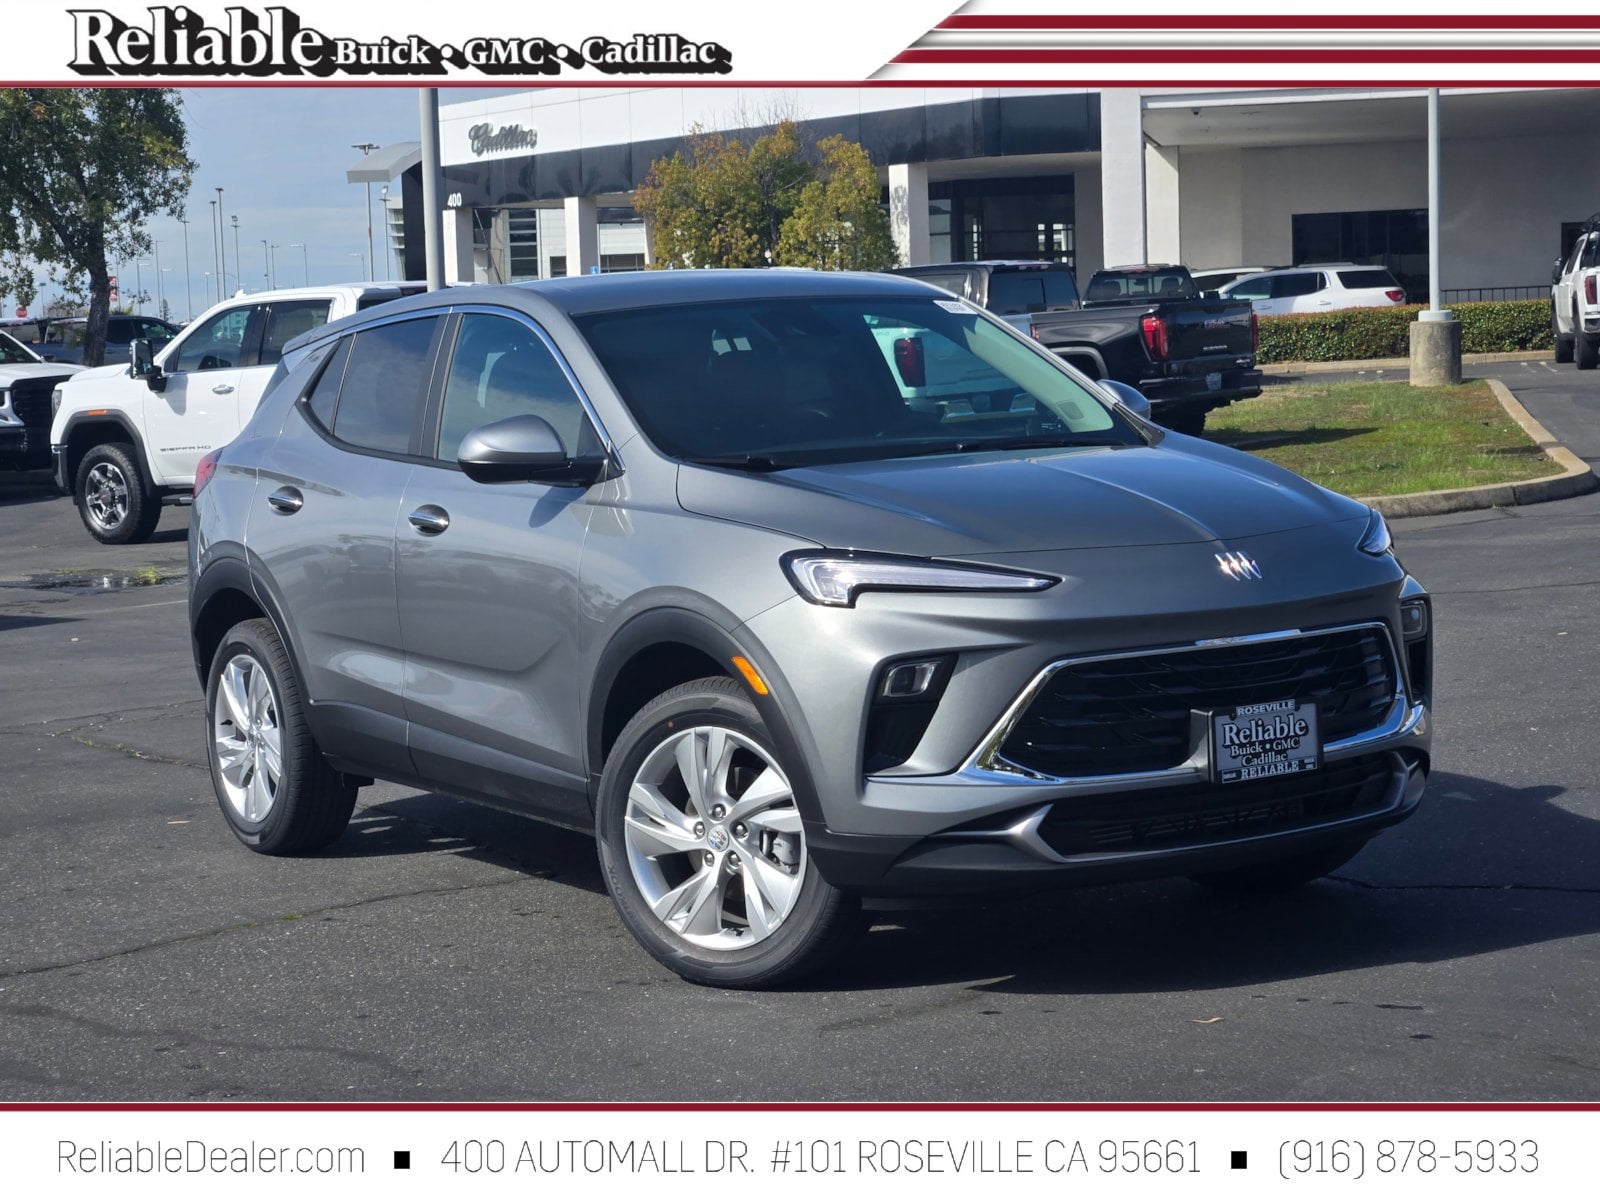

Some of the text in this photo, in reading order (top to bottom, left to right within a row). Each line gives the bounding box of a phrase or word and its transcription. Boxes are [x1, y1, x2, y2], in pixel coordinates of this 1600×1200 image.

[447, 192, 462, 207] 400
[1237, 700, 1295, 716] ROSEVILLE
[1222, 714, 1308, 746] Reliable
[1230, 737, 1300, 757] Buick GMC
[1242, 752, 1287, 766] Cadillac
[1241, 761, 1299, 779] RELIABLE
